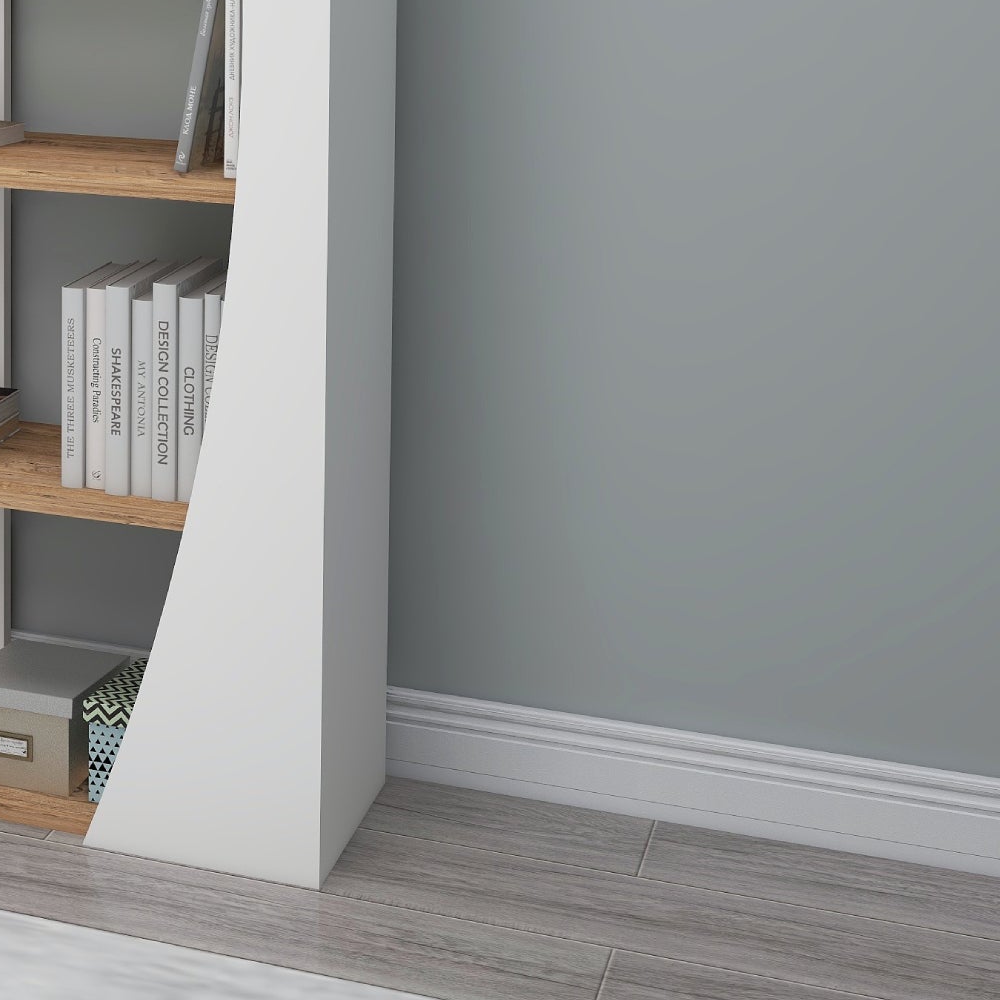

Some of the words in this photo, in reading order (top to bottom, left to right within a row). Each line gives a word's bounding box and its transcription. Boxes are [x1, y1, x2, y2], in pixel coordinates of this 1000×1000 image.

[182, 112, 193, 135] КЛОД
[187, 85, 197, 111] МОНЕ
[66, 318, 75, 393] MUSKETEERS
[91, 337, 102, 388] Constructing
[137, 360, 146, 379] MY
[158, 320, 169, 373] DESIGN
[66, 396, 75, 433] THREE
[111, 348, 122, 436] SHAKESPEARE
[137, 382, 146, 437] ANTONIA
[183, 366, 195, 436] CLOTHING
[157, 377, 169, 465] COLLECTION
[66, 436, 75, 459] THE
